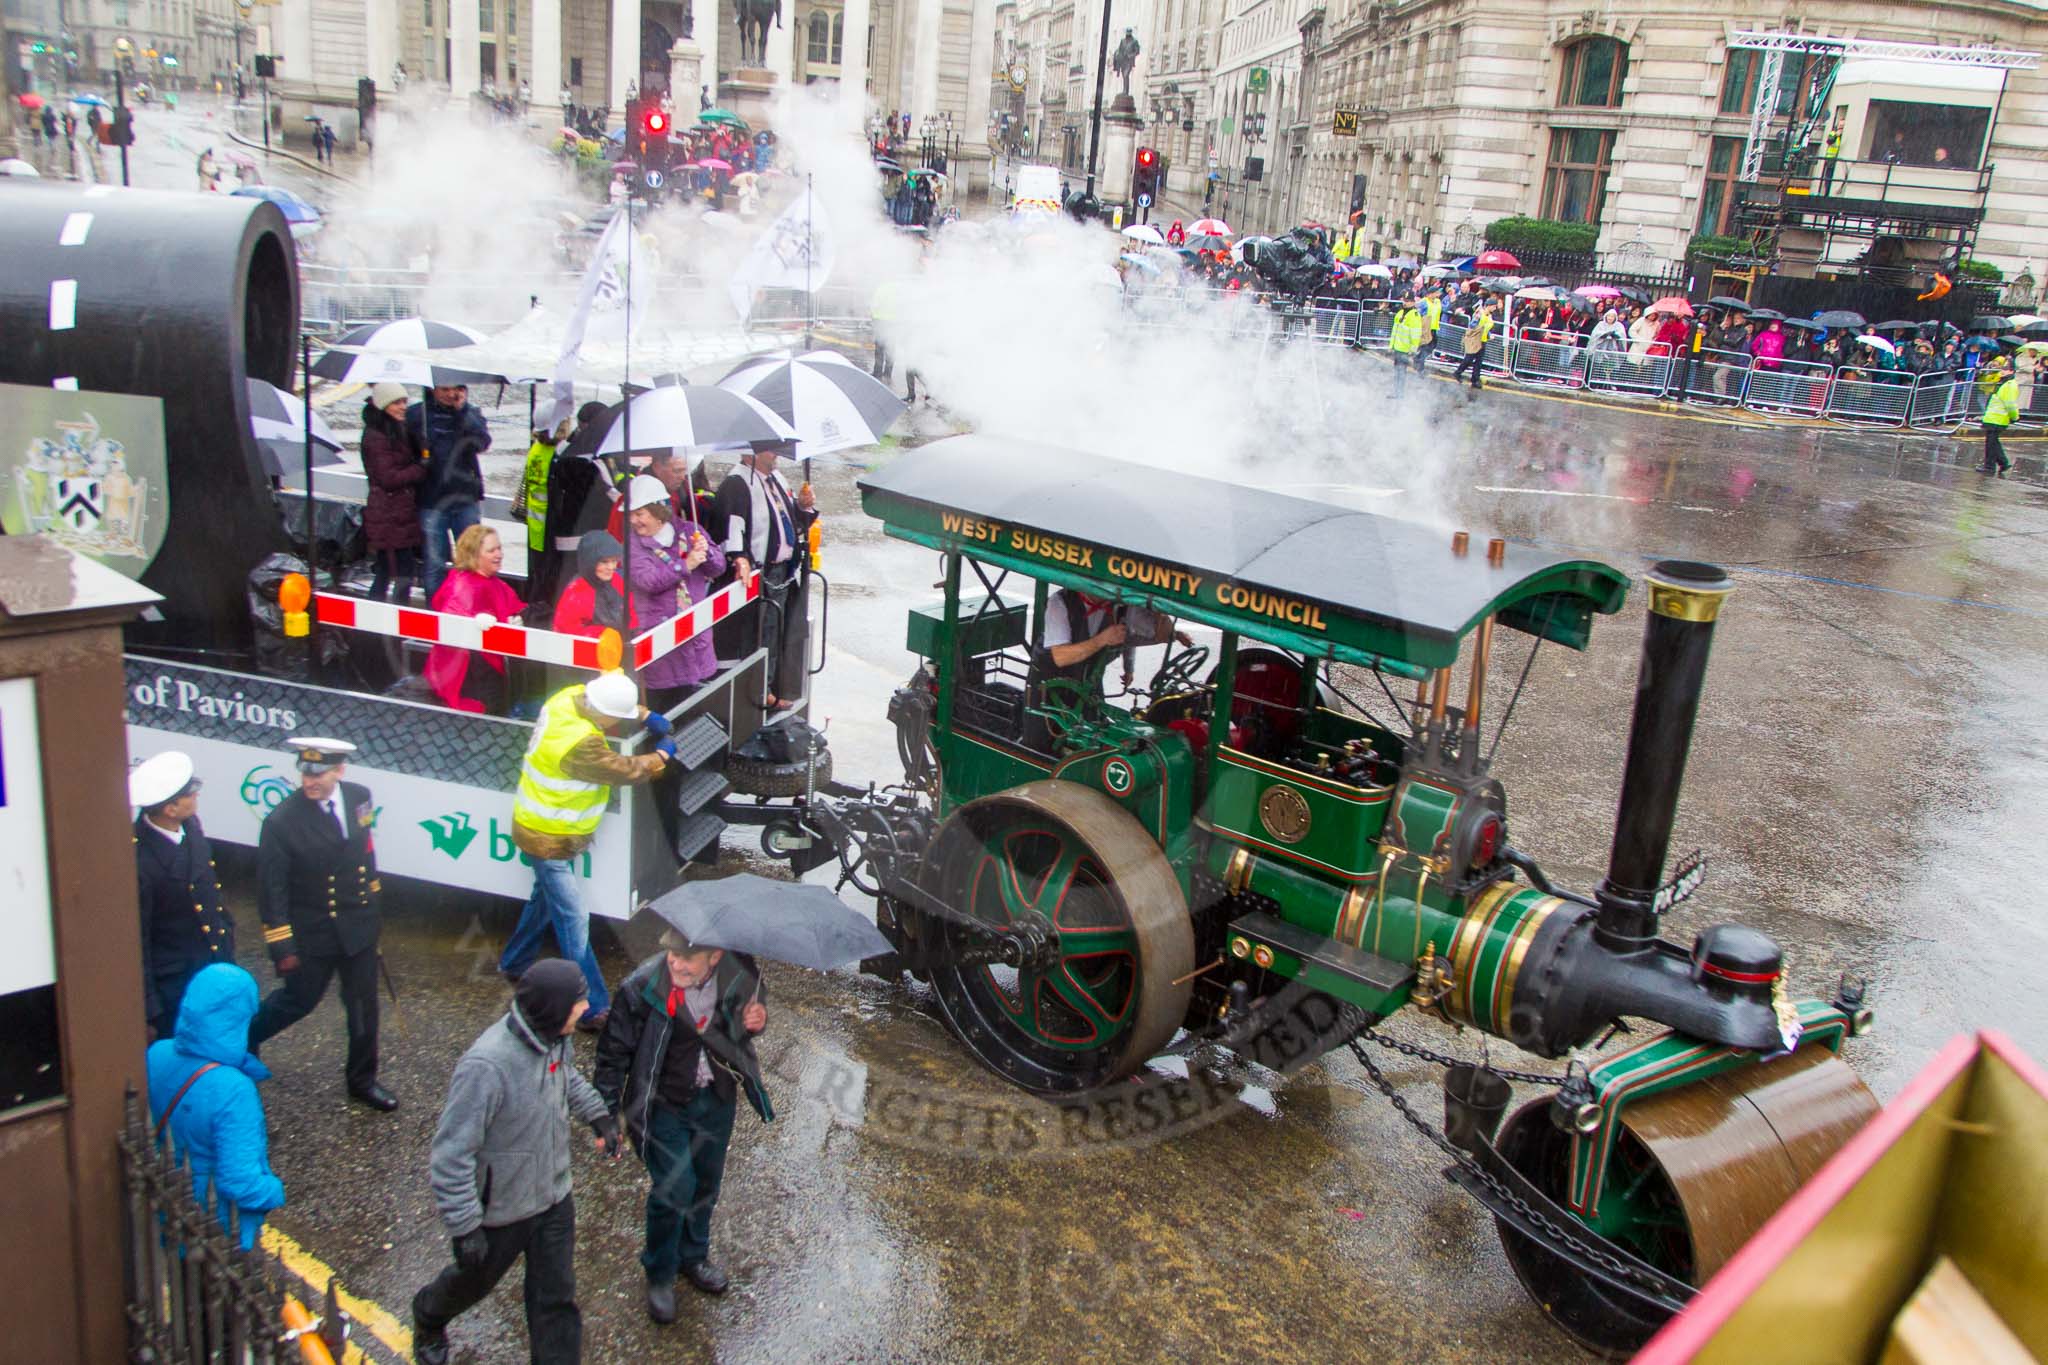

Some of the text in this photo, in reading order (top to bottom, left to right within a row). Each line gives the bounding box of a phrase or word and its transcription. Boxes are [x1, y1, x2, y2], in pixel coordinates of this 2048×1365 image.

[941, 511, 1328, 631] WEST SUSSEX COUNTY COUNCIL
[134, 675, 298, 731] of Paviors
